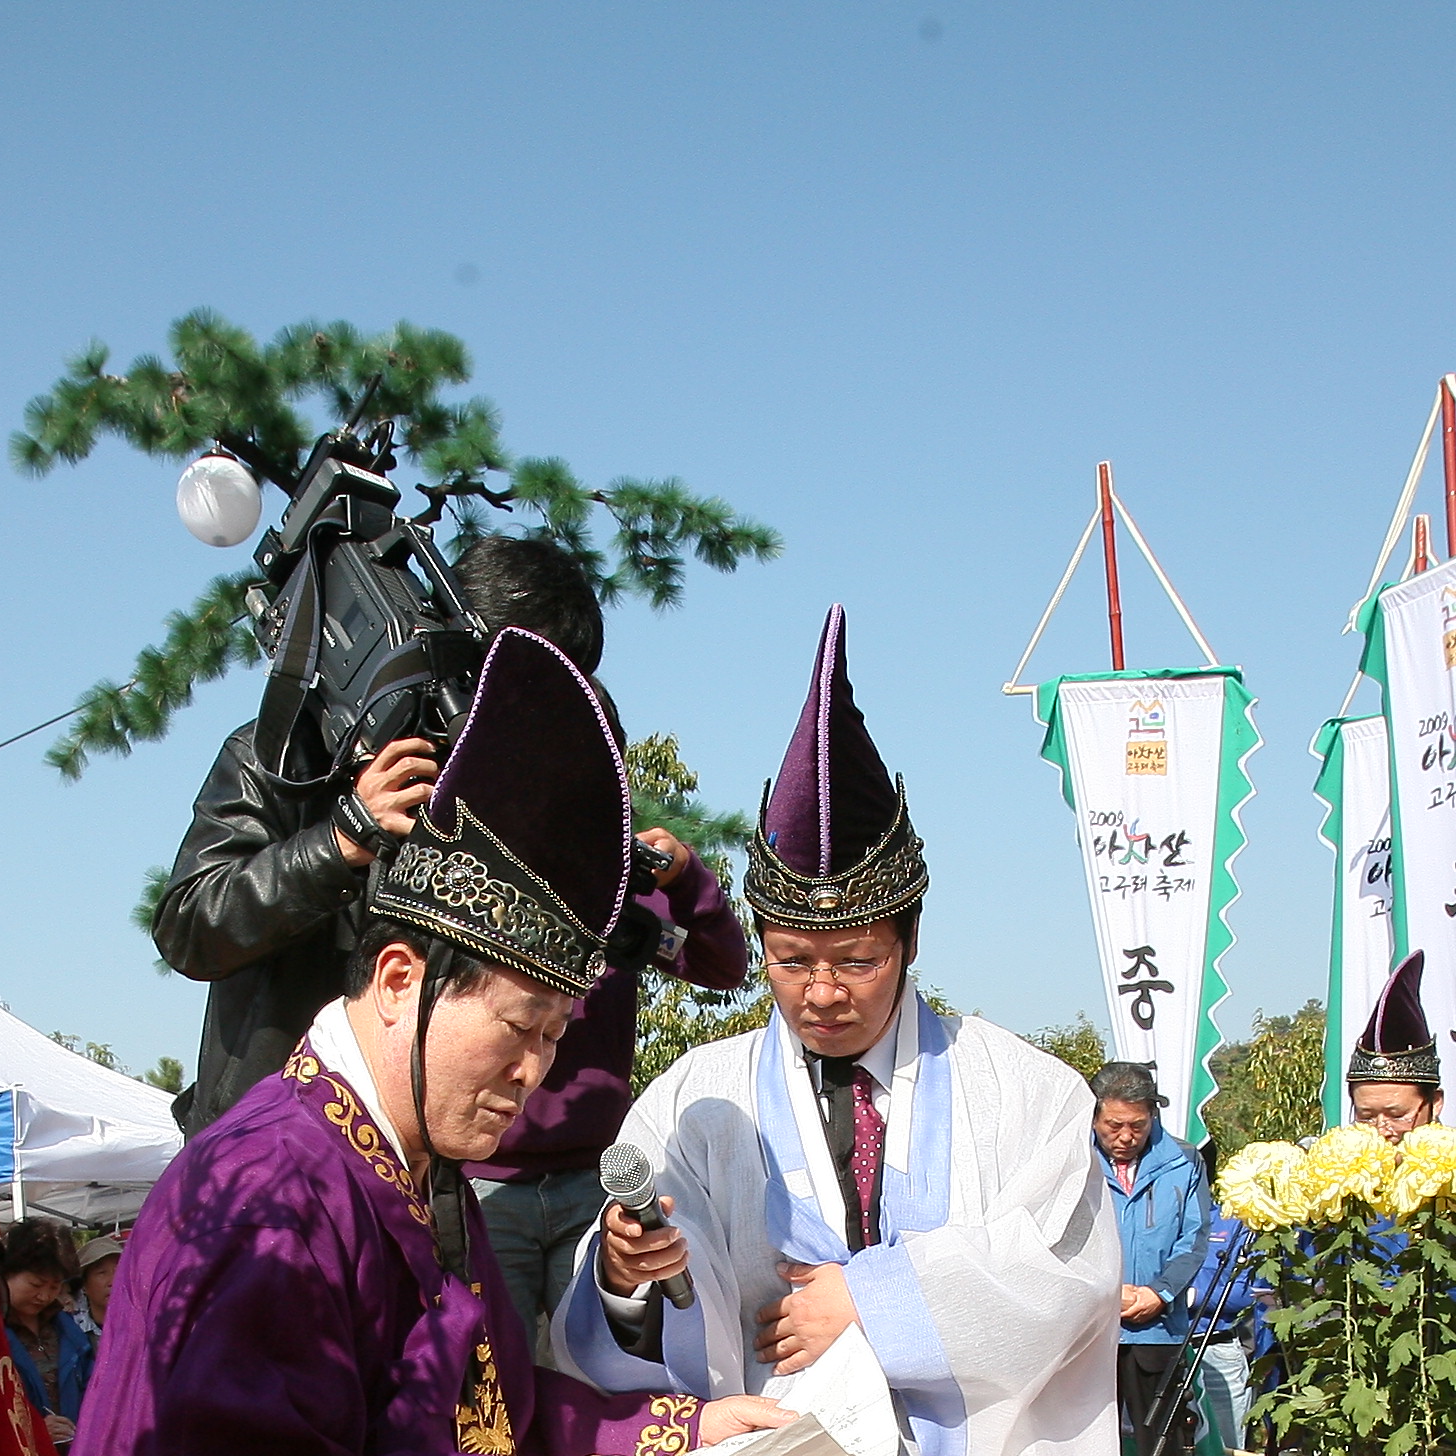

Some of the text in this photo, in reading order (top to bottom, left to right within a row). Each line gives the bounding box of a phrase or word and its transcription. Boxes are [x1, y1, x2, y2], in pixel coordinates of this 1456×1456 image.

[1418, 711, 1448, 737] 2009
[337, 794, 363, 833] Canon
[1089, 810, 1124, 827] 2009
[1367, 837, 1392, 855] 200
[1099, 869, 1195, 901] 고구려 축제
